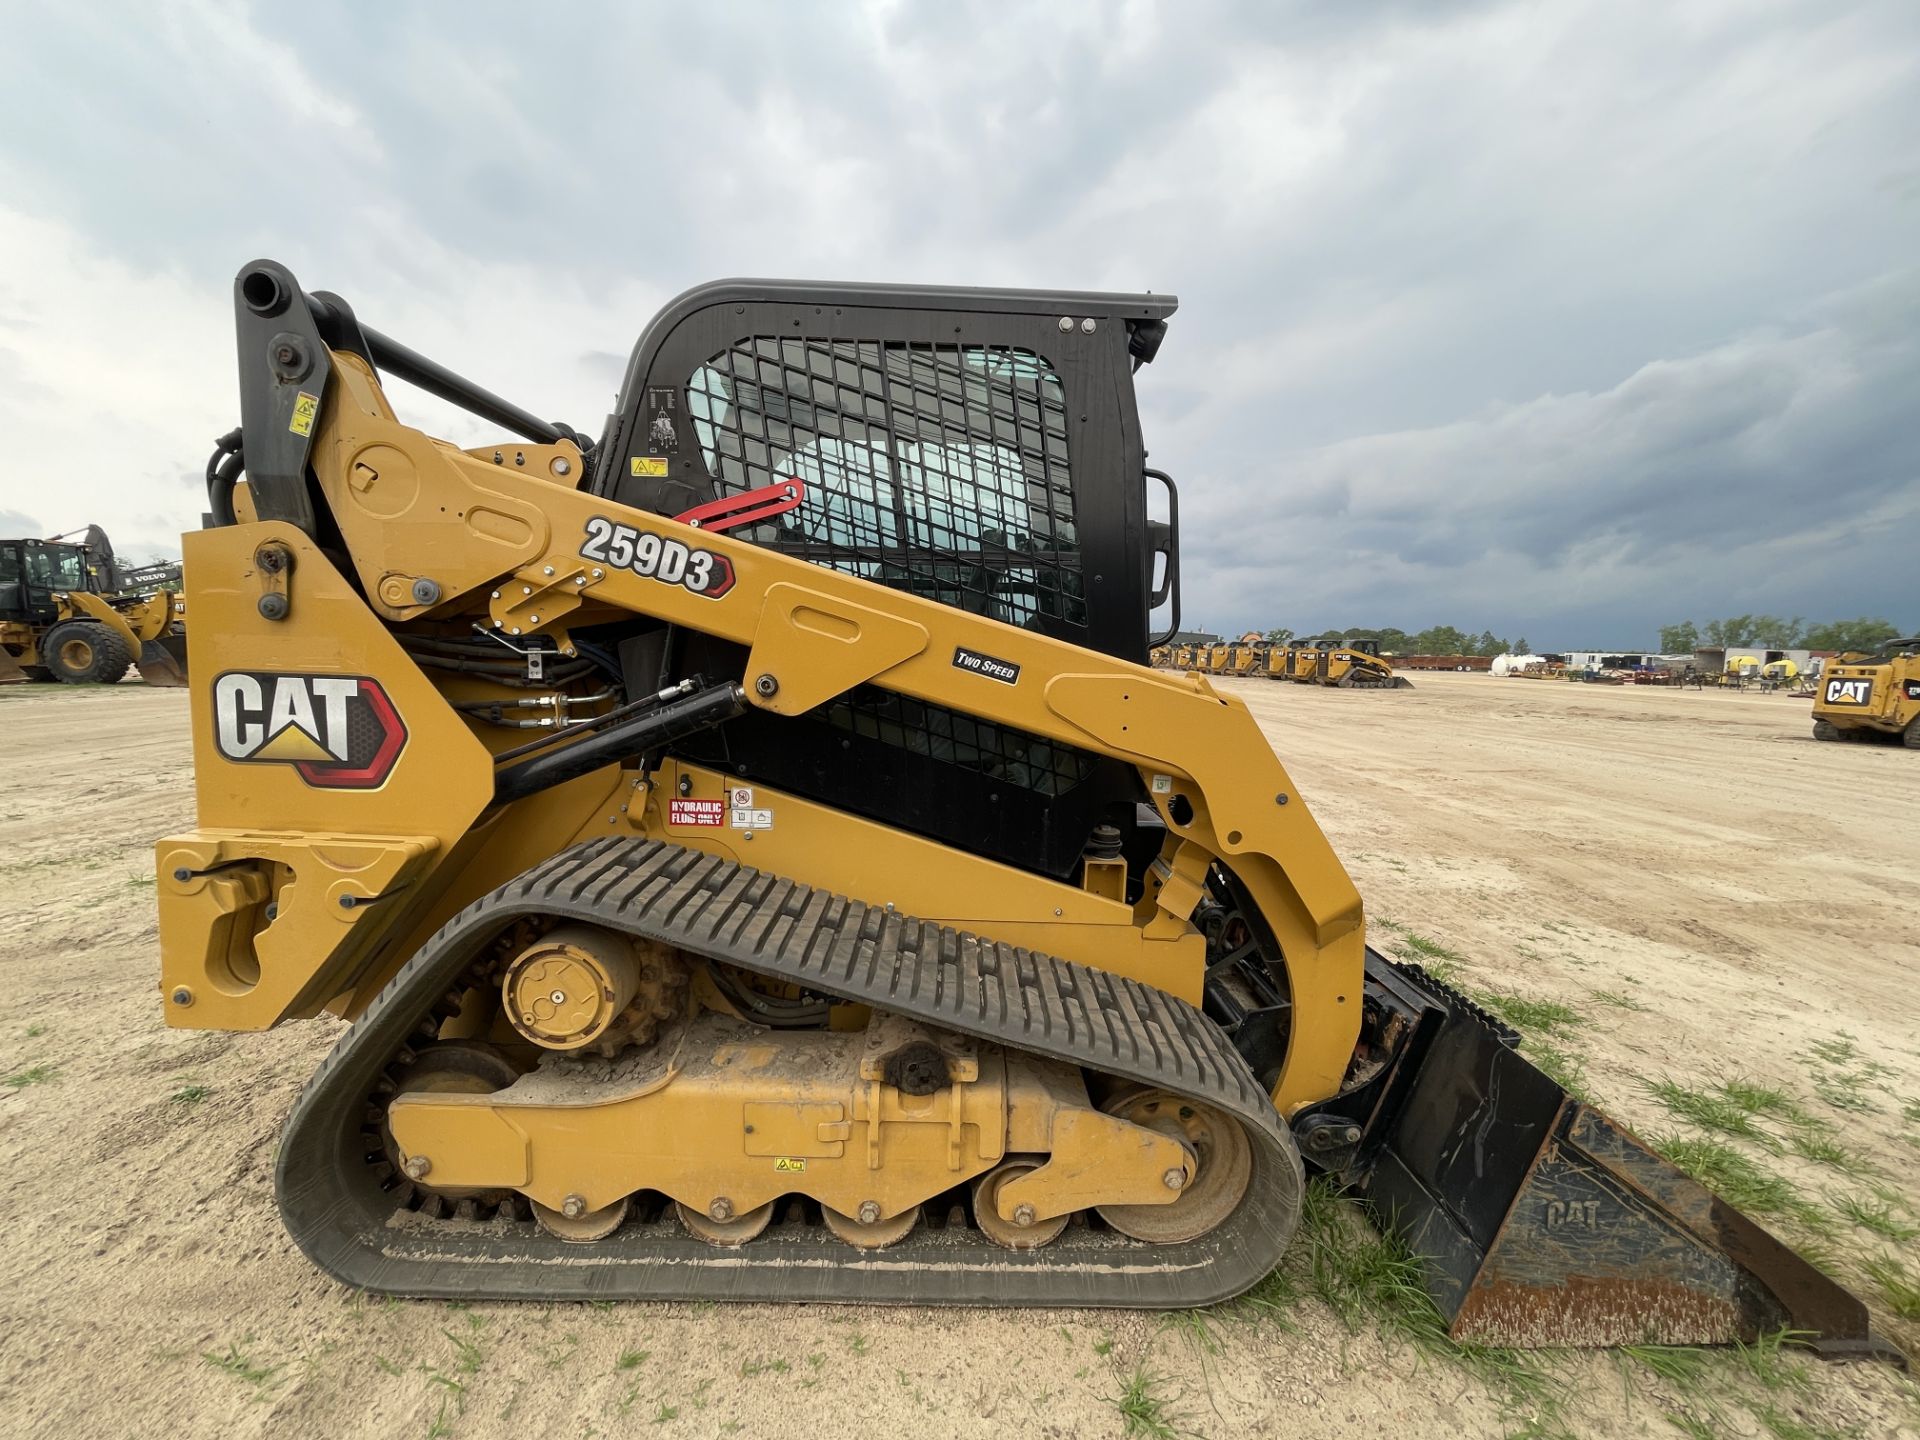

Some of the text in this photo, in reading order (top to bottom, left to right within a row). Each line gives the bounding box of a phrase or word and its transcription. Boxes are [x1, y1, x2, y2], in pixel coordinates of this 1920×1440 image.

[582, 518, 714, 591] 259D3
[135, 572, 167, 582] VOLVO
[174, 603, 185, 612] AT
[957, 652, 1015, 679] TWO SPEED
[1826, 681, 1870, 703] CAT
[216, 673, 358, 762] CAT
[671, 801, 722, 813] HYDRAULIC
[671, 812, 721, 826] FLUID ONLY
[1547, 1200, 1601, 1231] CAT
